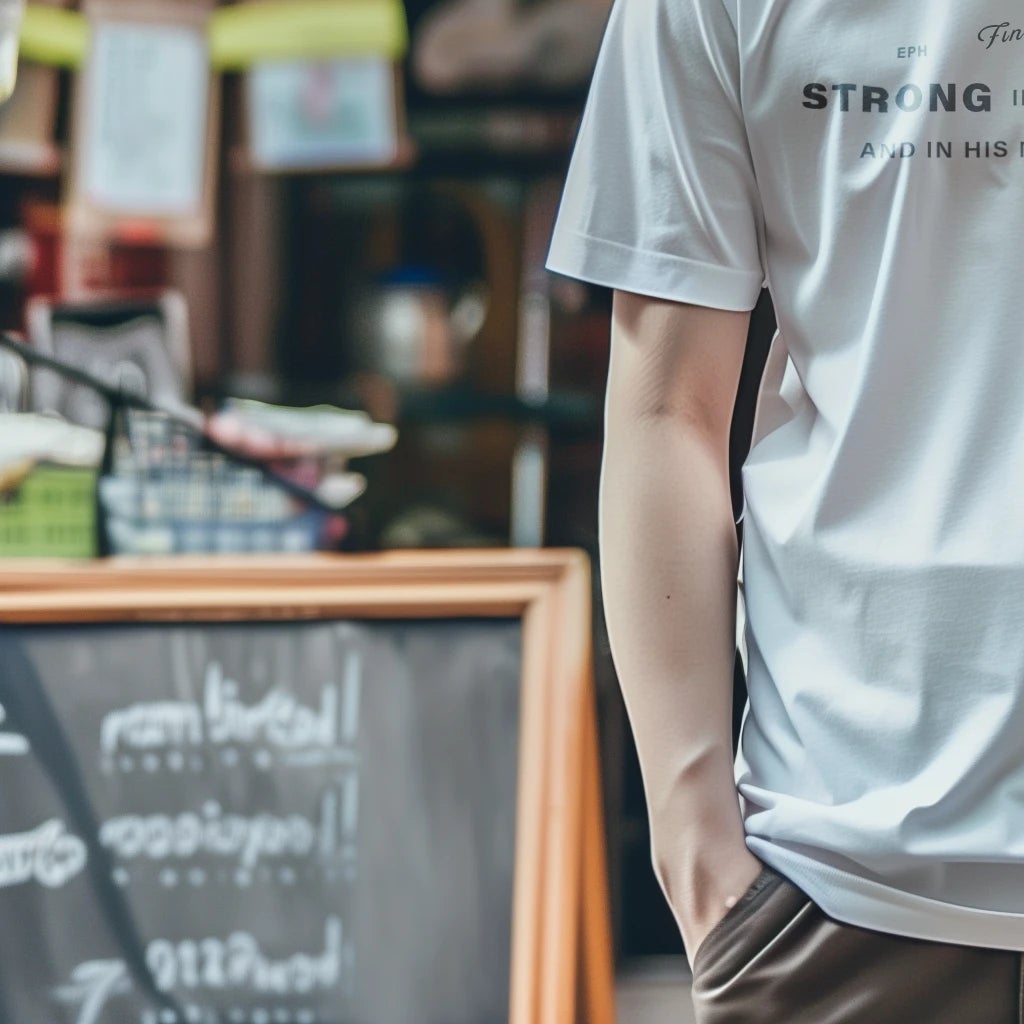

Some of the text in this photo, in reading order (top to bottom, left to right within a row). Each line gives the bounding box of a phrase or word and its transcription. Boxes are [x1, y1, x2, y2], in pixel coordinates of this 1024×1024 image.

[896, 44, 928, 59] EPH
[802, 82, 992, 113] STRONG
[860, 141, 916, 159] AND
[927, 141, 952, 159] IN
[964, 141, 1008, 159] HIS
